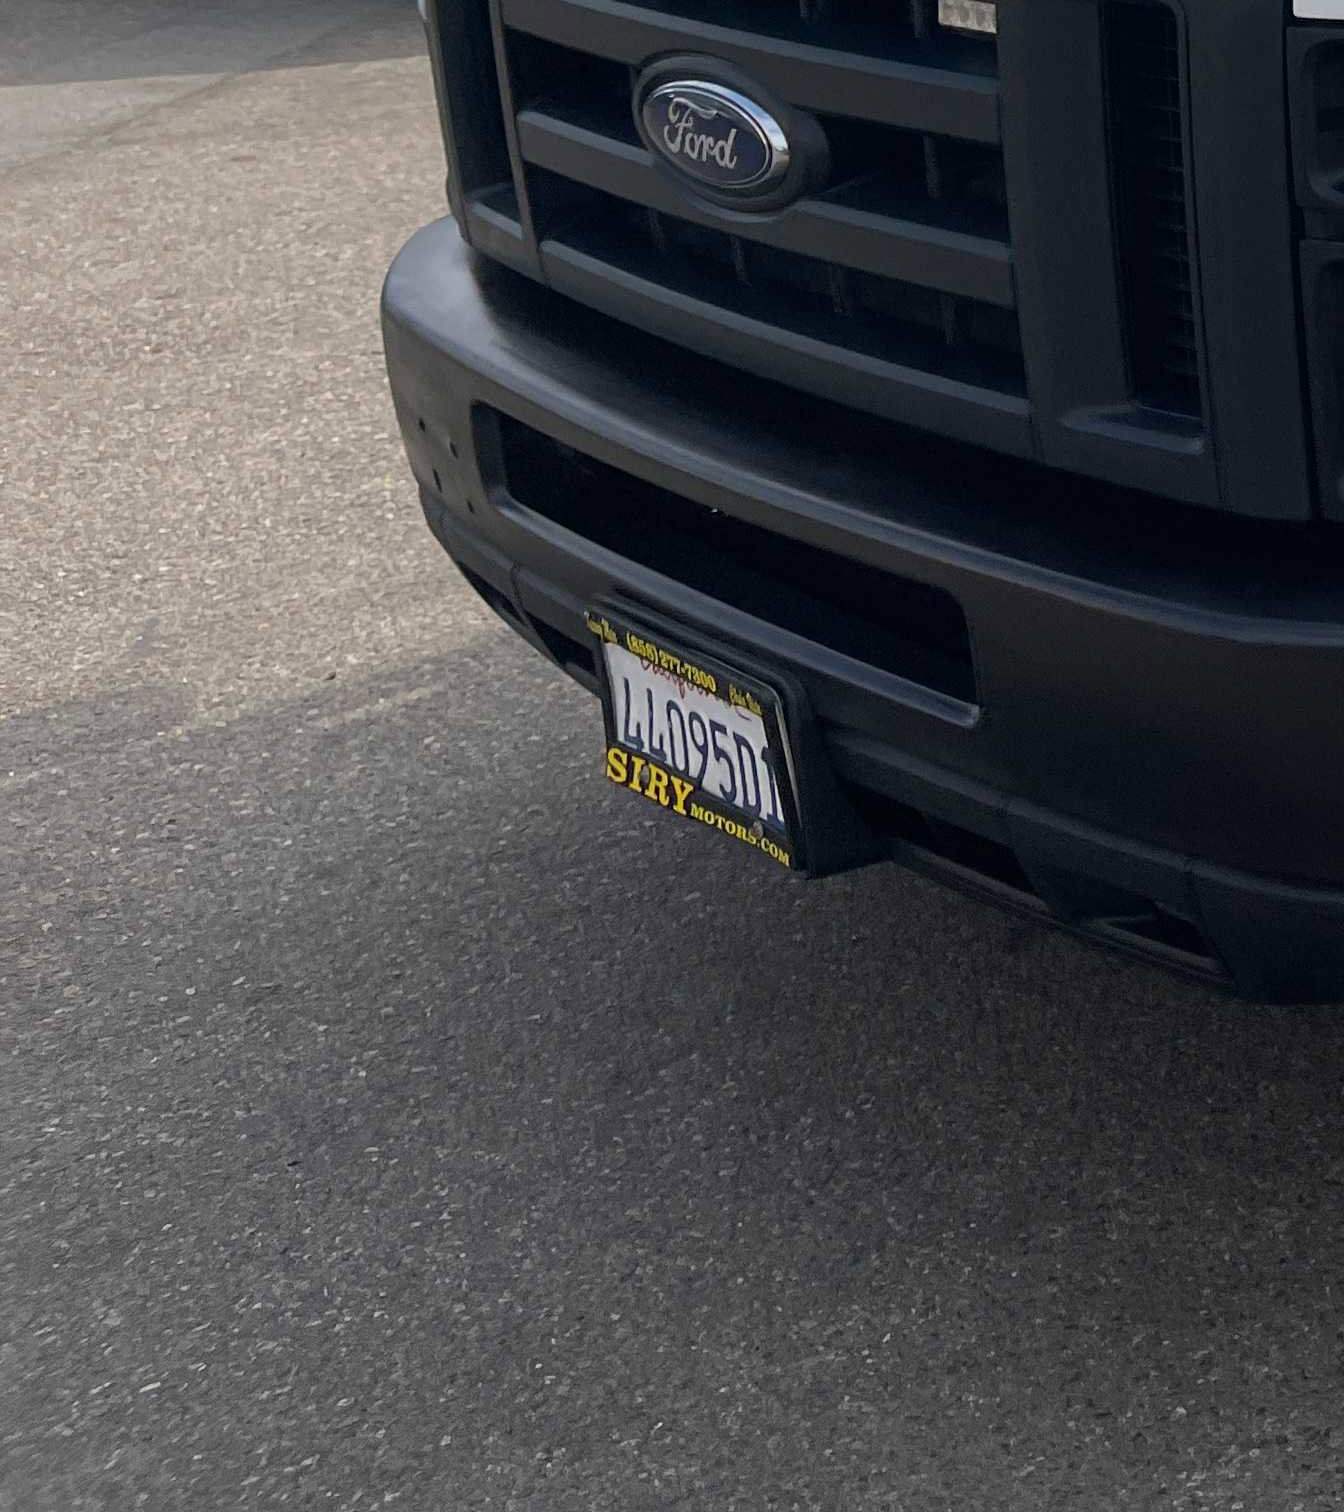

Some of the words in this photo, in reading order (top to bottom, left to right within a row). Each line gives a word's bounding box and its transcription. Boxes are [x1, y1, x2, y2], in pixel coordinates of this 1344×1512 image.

[663, 96, 738, 170] Ford
[606, 746, 695, 817] SIRY
[690, 802, 791, 867] MOTORS.COM
